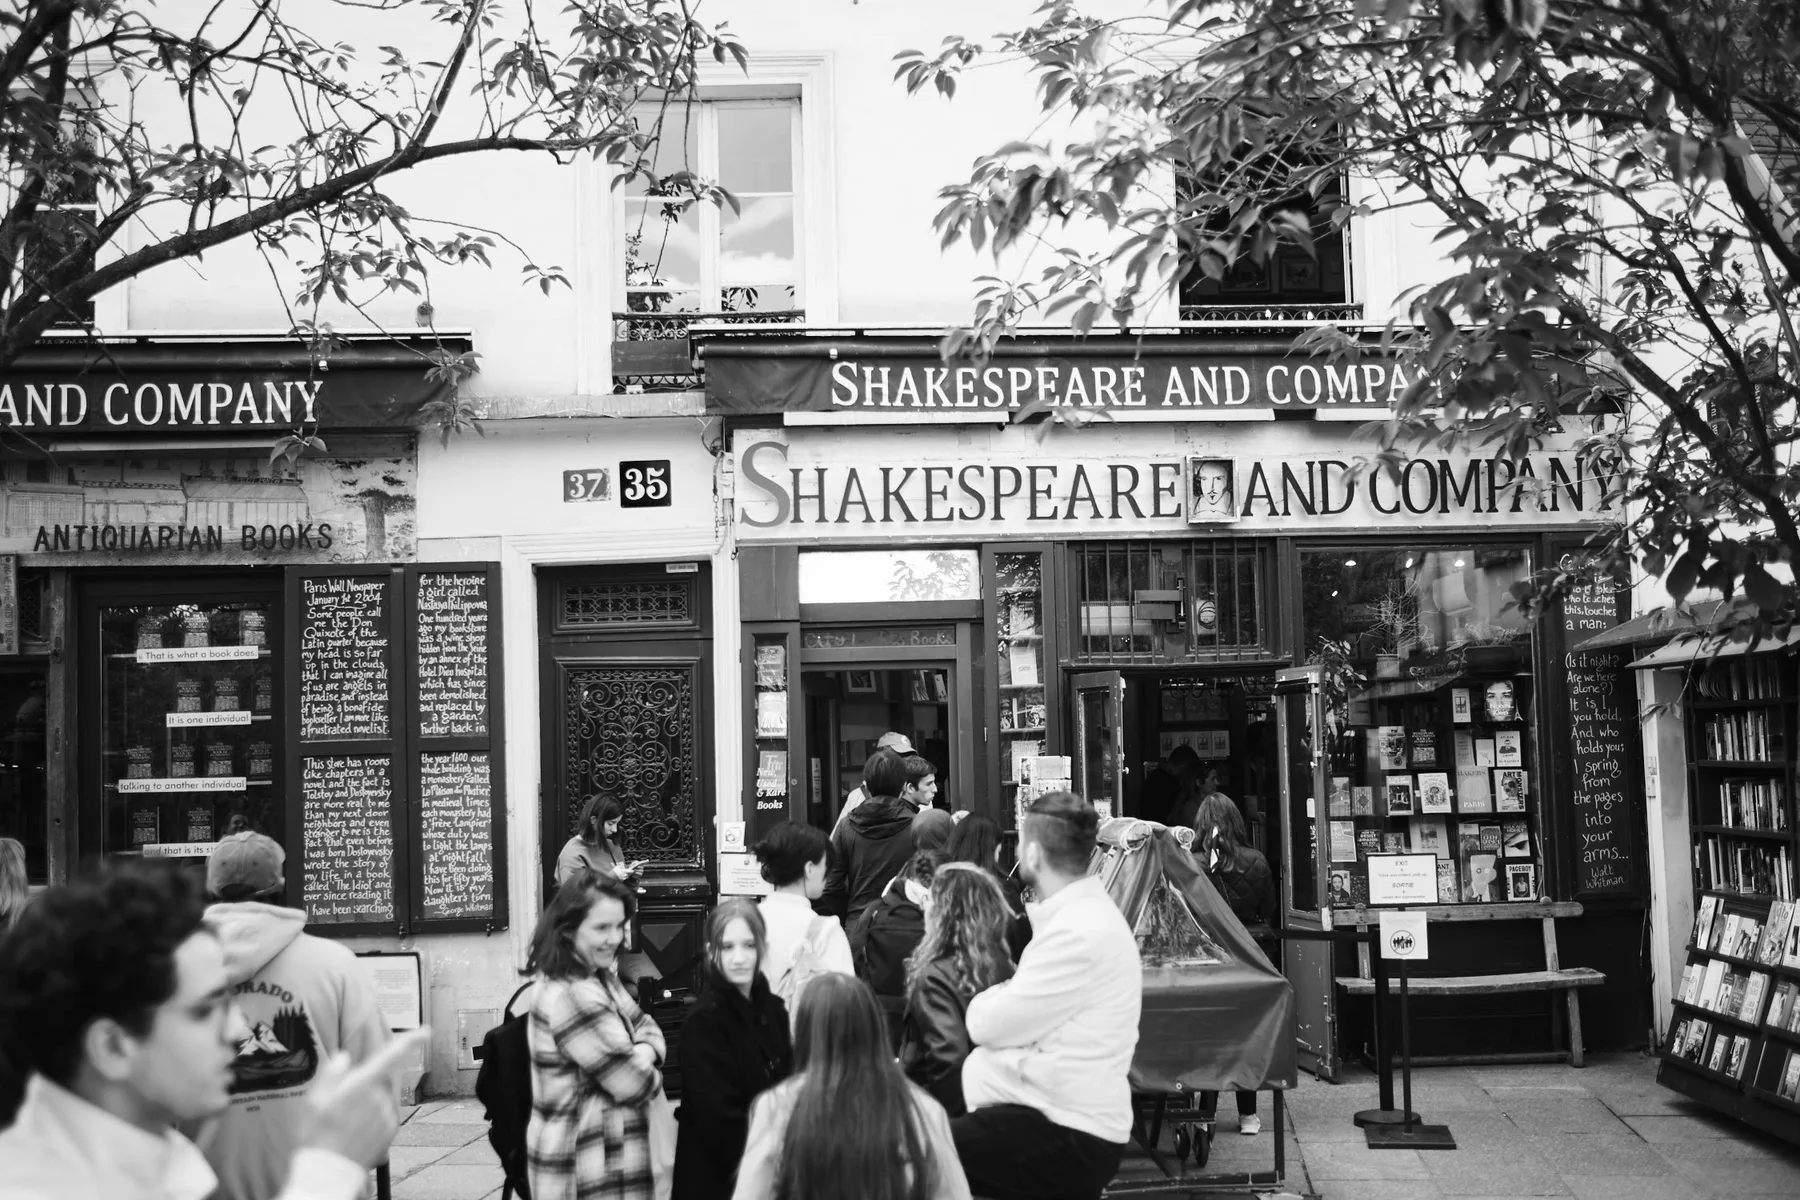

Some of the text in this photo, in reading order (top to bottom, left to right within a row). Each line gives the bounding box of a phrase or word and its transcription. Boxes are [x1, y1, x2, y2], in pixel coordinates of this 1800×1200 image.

[830, 360, 1147, 407] SHAKESPEARE
[1162, 366, 1251, 405] AND
[0, 381, 324, 426] AND COMPANY
[570, 473, 603, 498] 37
[625, 468, 667, 500] 35
[739, 440, 1625, 527] SHAKESPEARE AND COMPANY
[33, 523, 333, 552] ANTIQUARIAN BOOKS
[420, 574, 485, 586] for the heroine
[304, 579, 385, 595] Paris Wall Newspaper
[427, 587, 446, 599] girl
[449, 584, 479, 596] called
[307, 594, 339, 606] January
[354, 593, 382, 604] 2004
[307, 608, 381, 620] Some people call
[1584, 605, 1616, 616] touches
[332, 619, 348, 627] the
[353, 618, 372, 628] Don
[1566, 620, 1606, 630] a man;
[304, 627, 378, 639] Quixote of the
[911, 630, 953, 645] Books
[302, 637, 387, 649] Latin quarter because
[146, 652, 164, 660] That
[168, 651, 174, 659] is
[302, 651, 315, 662] my
[318, 650, 340, 658] head
[344, 649, 351, 658] is
[367, 647, 382, 658] far
[306, 663, 316, 672] up
[334, 660, 348, 669] the
[353, 660, 384, 668] clouds
[1565, 653, 1619, 672] (Is it night?
[1567, 671, 1581, 683] Are
[1597, 672, 1616, 682] here
[1573, 683, 1613, 695] alone?)
[420, 700, 485, 715] and replaced by
[1570, 695, 1606, 711] It is I
[206, 713, 248, 723] individual
[432, 713, 482, 723] a garden.
[1573, 711, 1621, 726] you hold,
[307, 724, 351, 737] frustrated
[354, 722, 390, 734] novelist.
[421, 722, 485, 734] Further back in
[1571, 726, 1619, 739] And who
[1577, 740, 1624, 758] holds you;
[304, 757, 390, 769] This store has rooms
[1574, 759, 1621, 778] I spring
[304, 769, 323, 778] like
[326, 768, 363, 781] chapters
[367, 768, 374, 776] in
[757, 768, 776, 777] New,
[121, 782, 150, 791] talking
[165, 781, 198, 789] another
[202, 780, 244, 788] individual
[757, 779, 777, 787] Used
[1582, 774, 1610, 791] from
[757, 788, 786, 797] & Rare
[757, 800, 783, 809] Books
[1574, 791, 1623, 809] the pages
[1585, 810, 1611, 827] into
[423, 828, 488, 843] whose duty was
[1582, 831, 1612, 849] your
[145, 847, 161, 855] and
[164, 846, 181, 854] that
[1584, 847, 1628, 862] arms...
[304, 858, 388, 870] wrote the story of
[1591, 865, 1614, 878] Walt
[1586, 876, 1624, 889] Whitman
[305, 902, 393, 919] I have been searching
